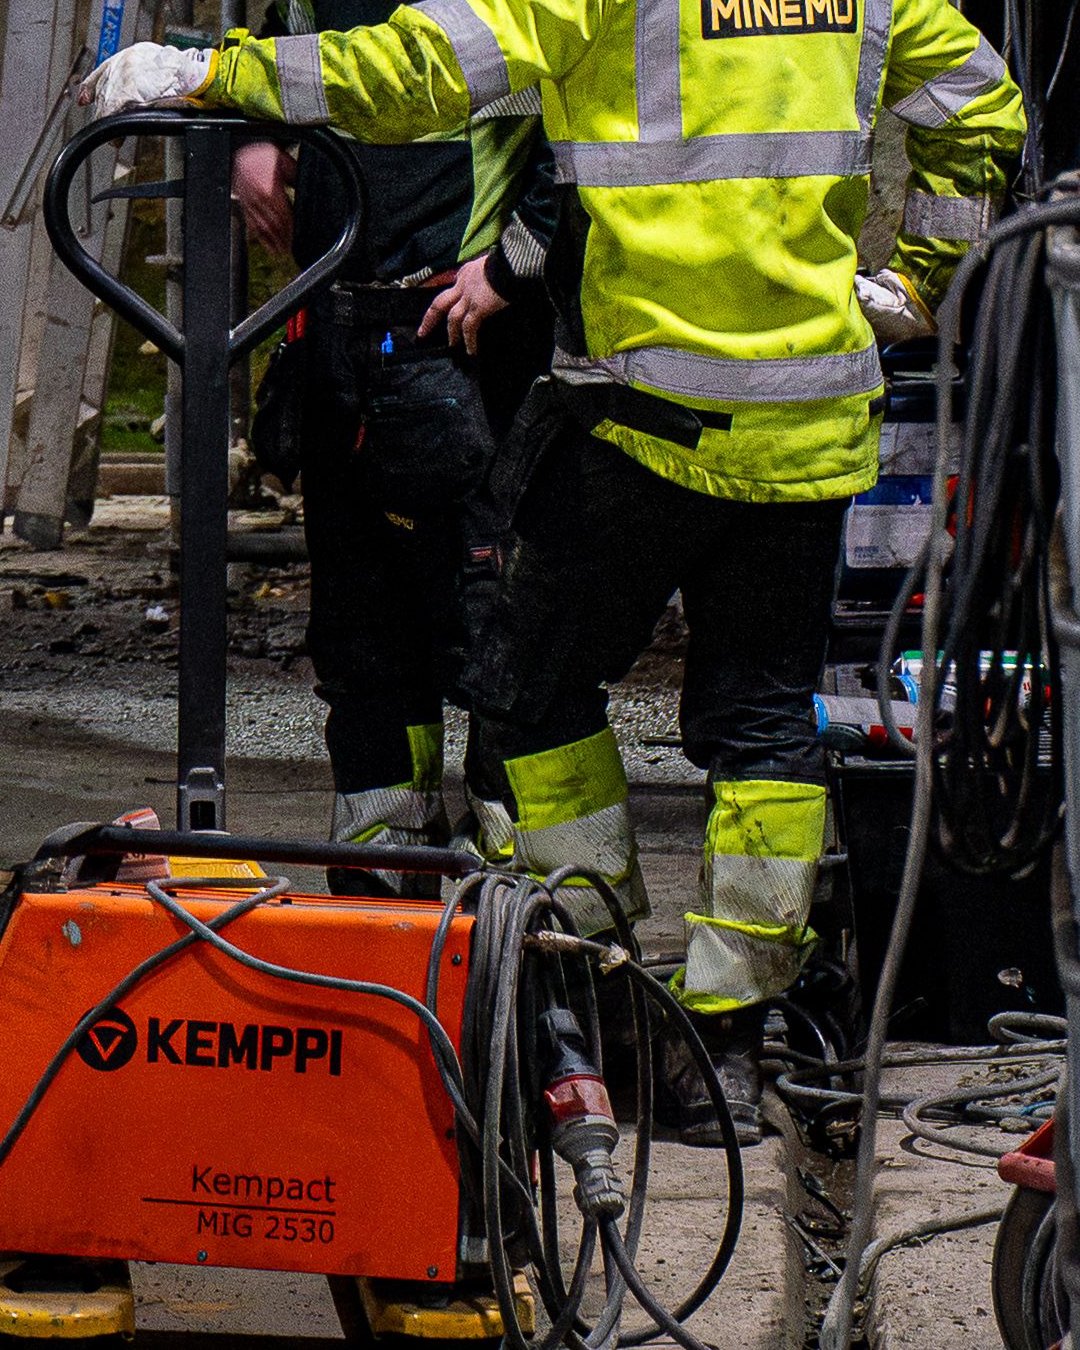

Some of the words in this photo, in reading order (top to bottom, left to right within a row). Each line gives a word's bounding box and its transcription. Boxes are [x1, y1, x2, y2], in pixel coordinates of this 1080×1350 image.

[147, 1017, 343, 1076] KEMPPI
[191, 1165, 337, 1204] Kempact
[197, 1210, 253, 1238] MIG
[264, 1215, 335, 1244] 2530
